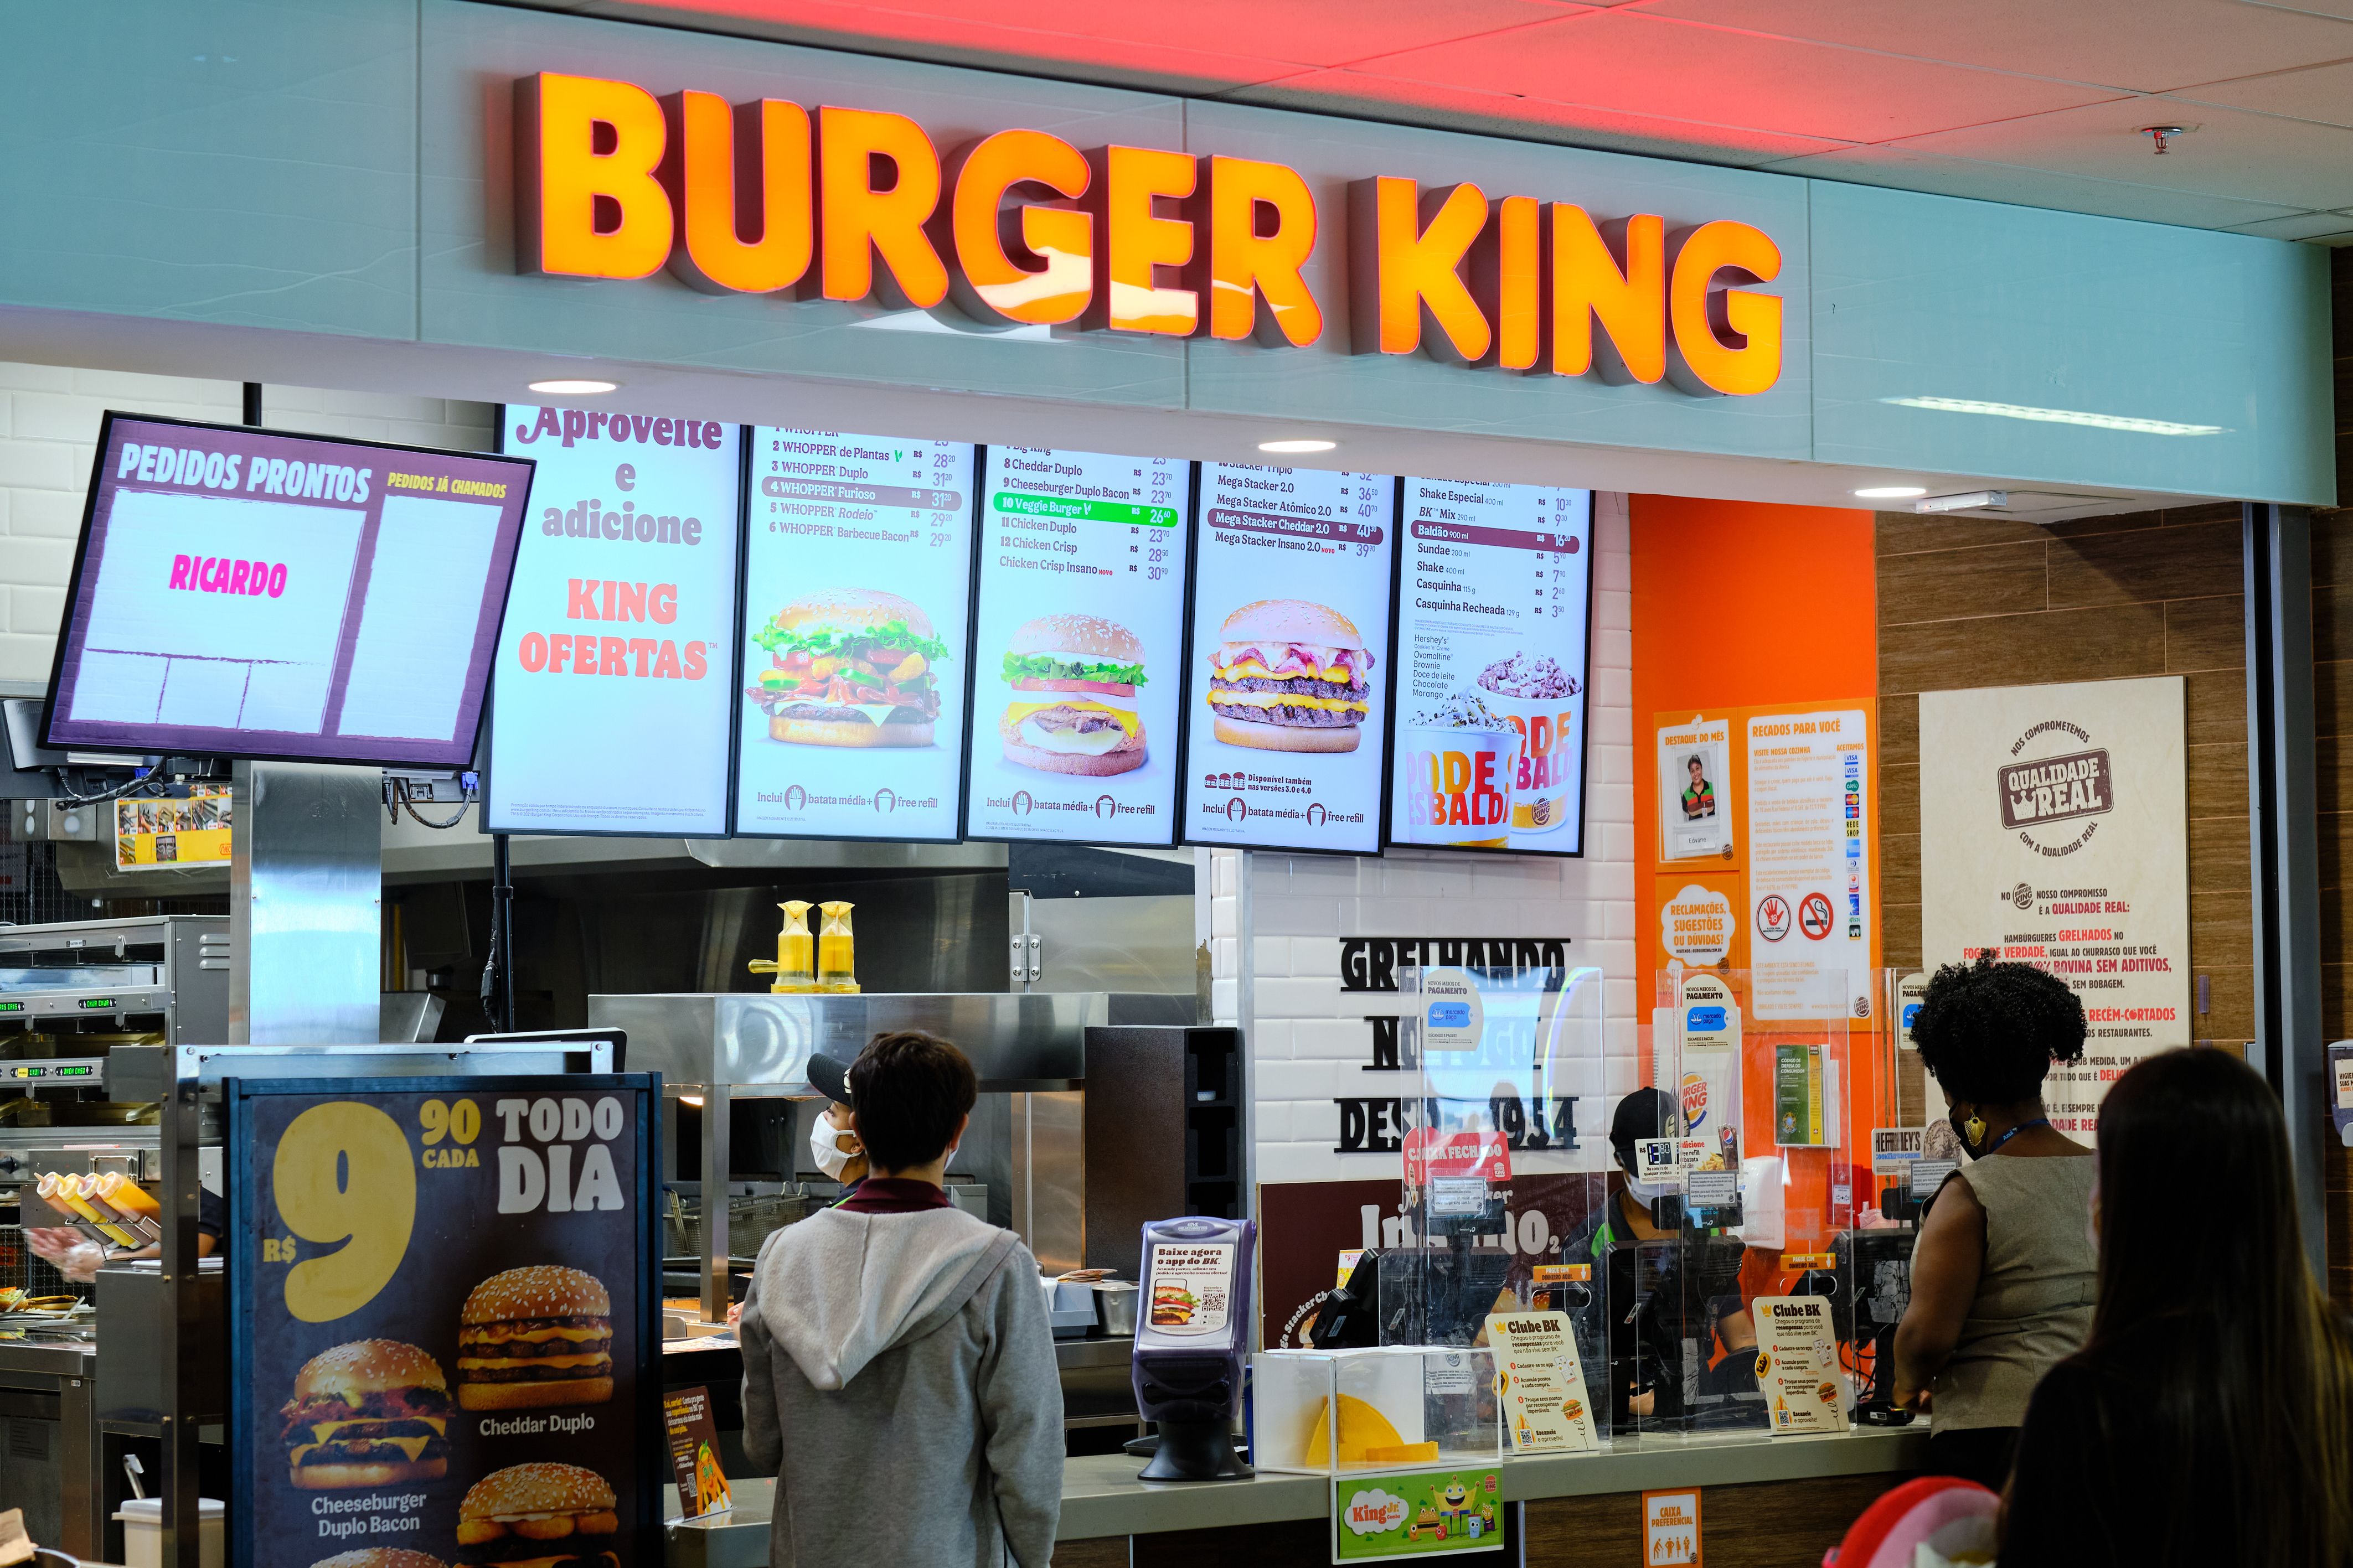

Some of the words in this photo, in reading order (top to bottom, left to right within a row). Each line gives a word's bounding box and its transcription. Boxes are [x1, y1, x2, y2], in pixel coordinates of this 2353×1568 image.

[540, 72, 1322, 347] BURGER
[1377, 175, 1783, 396] KING
[516, 407, 723, 450] Aproveite
[773, 441, 779, 451] 2
[783, 442, 836, 456] WHOPPER
[840, 448, 852, 457] de
[854, 448, 889, 460] Plantas
[117, 443, 242, 490] PEDIDOS
[246, 457, 372, 503] PRONTOS
[615, 463, 636, 491] e
[388, 472, 434, 490] PEDIDOS
[436, 476, 448, 492] JÁ
[451, 479, 507, 499] CHAMADOS
[771, 482, 778, 491] 4
[781, 482, 834, 496] WHOPPER
[838, 487, 875, 500] Furioso
[1003, 478, 1009, 487] 9
[1011, 478, 1074, 495] Cheeseburger
[1075, 484, 1101, 498] Duplo
[1103, 487, 1129, 499] Bacon
[1217, 494, 1241, 508] Mega
[1243, 497, 1278, 510] Stacker
[1279, 501, 1316, 514] Atômico
[1318, 505, 1332, 516] 2.0
[1420, 488, 1446, 500] Shake
[1448, 491, 1483, 504] Especial
[542, 499, 702, 546] adicione
[1418, 524, 1448, 537] Baldão
[770, 522, 776, 532] 6
[780, 522, 833, 536] WHOPPER
[838, 528, 880, 540] Barbecue
[882, 530, 909, 542] Bacon
[1000, 556, 1038, 570] Chicken
[1040, 560, 1064, 573] Crisp
[1067, 562, 1097, 575] Insano
[169, 554, 287, 598] RICARDO
[567, 578, 678, 624] KING
[1416, 598, 1461, 612] Casquinha
[1463, 602, 1505, 615] Recheada
[519, 632, 708, 681] OFERTAS
[1413, 660, 1440, 670] Brownie
[1413, 670, 1429, 679] Doce
[1413, 680, 1448, 689] Chocolate
[1412, 689, 1443, 699] Morango
[1752, 723, 1790, 738] RECADOS
[1793, 722, 1817, 735] PARA
[1819, 720, 1840, 733] VOCÊ
[1665, 734, 1697, 746] DESTAQUE
[1700, 734, 1710, 743] DO
[1711, 731, 1724, 742] MÊS
[1836, 743, 1864, 752] ACEITAMOS
[1248, 774, 1283, 786] Disponível
[1285, 777, 1311, 786] também
[2008, 758, 2099, 791] QUALIDADE
[1260, 784, 1284, 793] versões
[2036, 779, 2102, 816] REAL
[1203, 803, 1225, 814] Inclui
[1248, 806, 1273, 817] batata
[1328, 812, 1344, 822] free
[1346, 813, 1364, 823] refill
[1847, 829, 1859, 837] SHOP
[2036, 890, 2057, 899] NOSSO
[2060, 888, 2107, 898] COMPROMISSO
[1670, 902, 1726, 916] RECLAMAÇÕES,
[2039, 905, 2043, 915] É
[2045, 907, 2050, 915] A
[2052, 903, 2101, 914] QUALIDADE
[2105, 902, 2129, 913] REAL:
[1674, 917, 1723, 932] SUGESTÕES
[1674, 934, 1685, 946] OU
[1688, 931, 1724, 945] DÚVIDAS?
[2004, 932, 2056, 943] HAMBÚRGUERES
[2059, 929, 2112, 941] GRELHADOS
[2114, 932, 2123, 940] NO
[2004, 946, 2048, 959] VERDADE,
[2050, 948, 2069, 957] IGUAL
[2071, 948, 2080, 956] AO
[2082, 946, 2120, 956] CHURRASCO
[2123, 946, 2137, 955] QUE
[2139, 944, 2156, 955] VOCÊ
[2053, 960, 2092, 974] BOVINA
[2096, 959, 2118, 973] SEM
[2122, 958, 2171, 972] ADITIVOS,
[2072, 980, 2087, 989] SEM
[2089, 979, 2125, 989] BOBAGEM.
[2098, 1028, 2153, 1038] RESTAURANTES.
[496, 1097, 625, 1142] TODO
[422, 1149, 480, 1169] CADA
[498, 1144, 625, 1214] DIA
[273, 1101, 417, 1323] 9
[264, 1236, 296, 1264] R$
[1508, 1320, 1542, 1333] Clube
[1542, 1319, 1561, 1332] BK
[480, 1416, 546, 1436] Cheddar
[550, 1415, 595, 1435] Duplo
[311, 1493, 427, 1515] Cheeseburger
[1660, 1506, 1681, 1517] CAIXA
[1353, 1505, 1386, 1524] King
[1652, 1516, 1693, 1527] PREFERENCIAL
[318, 1519, 367, 1539] Duplo
[370, 1515, 420, 1533] Bacon
